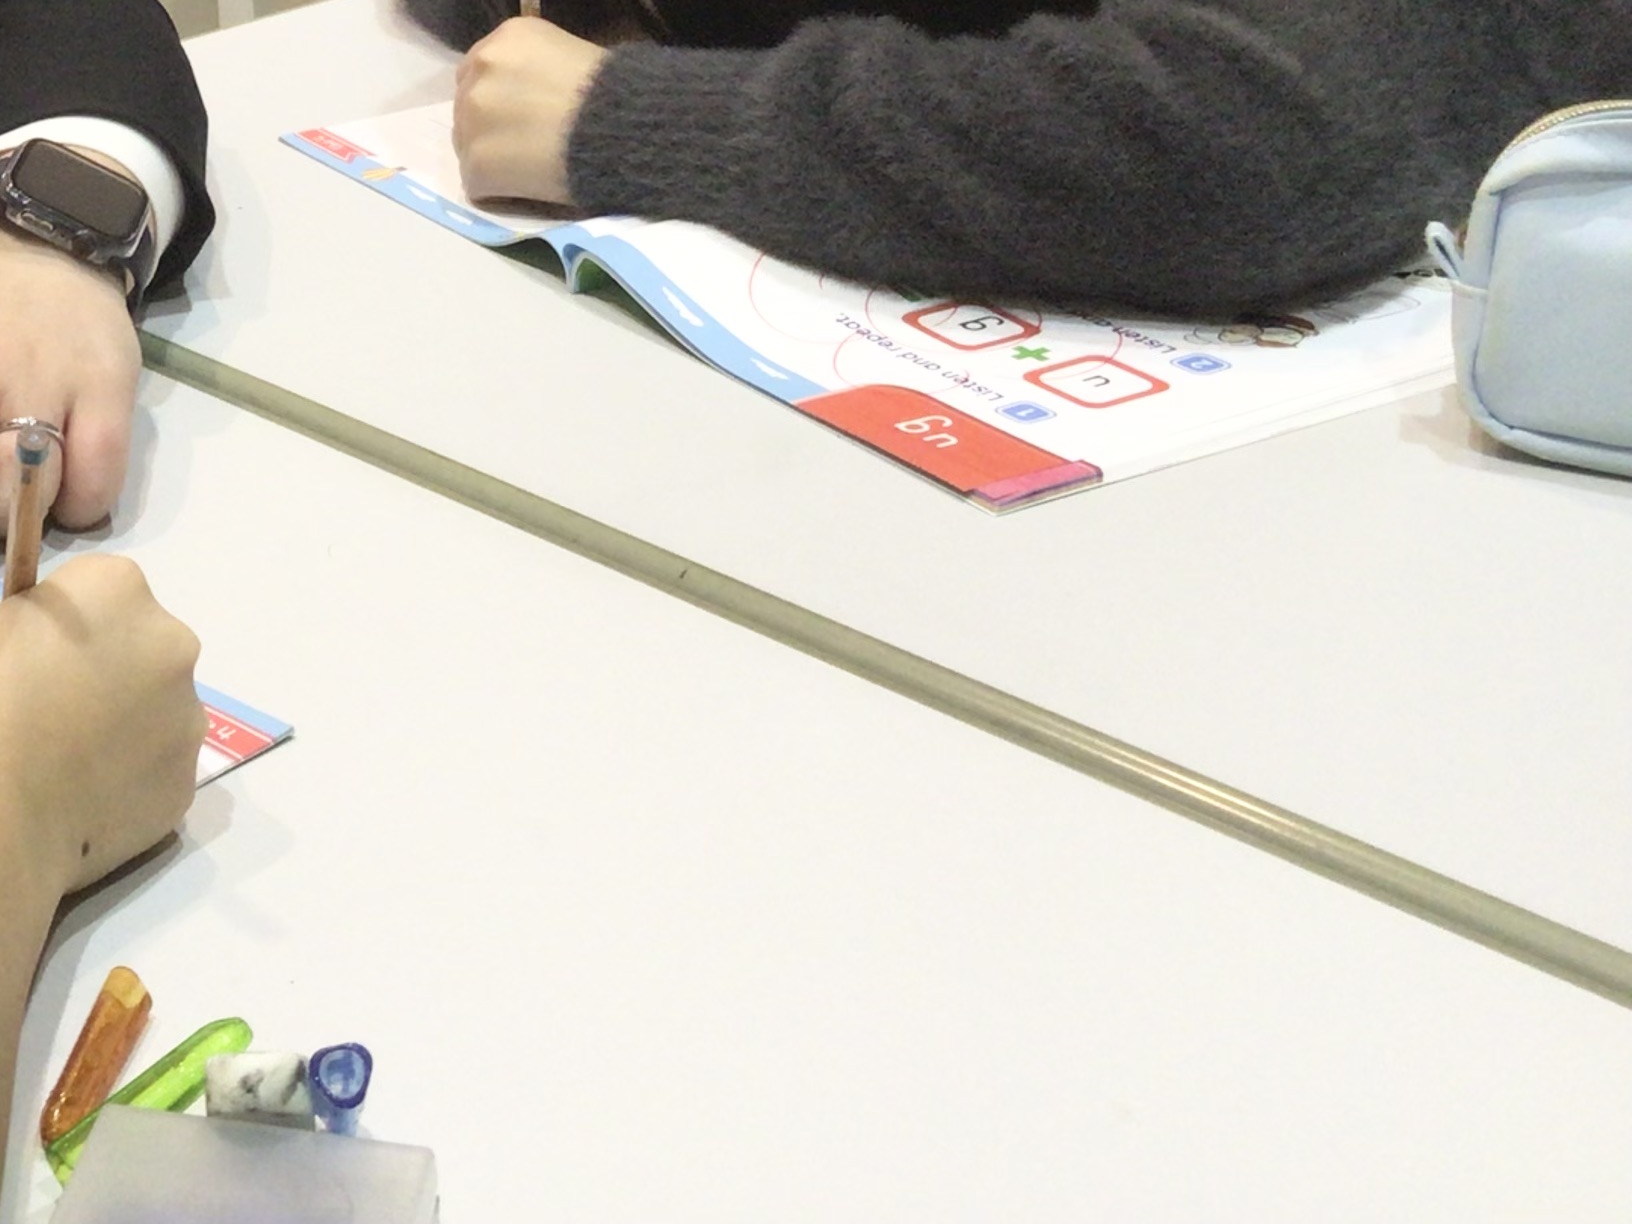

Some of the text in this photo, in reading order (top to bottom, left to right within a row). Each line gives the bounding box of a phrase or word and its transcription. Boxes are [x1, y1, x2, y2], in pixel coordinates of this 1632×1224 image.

[834, 312, 899, 353] repeat.
[898, 350, 942, 372] and
[942, 370, 1005, 402] Listen
[893, 415, 959, 449] ug
